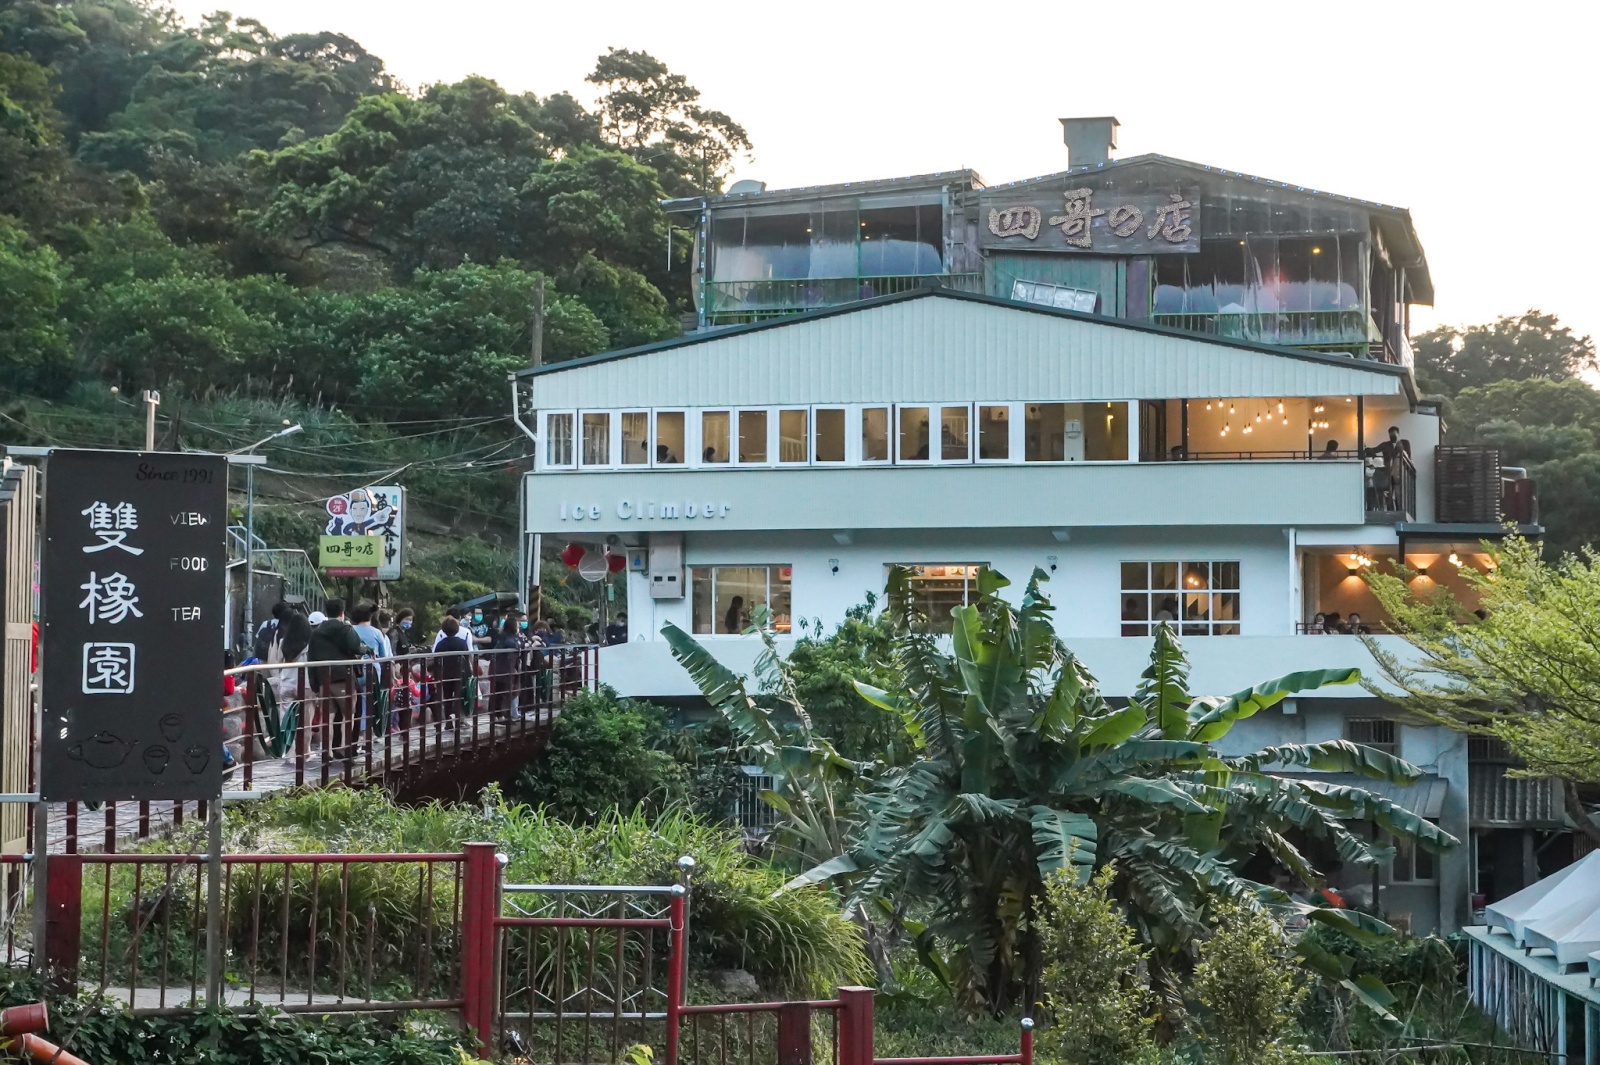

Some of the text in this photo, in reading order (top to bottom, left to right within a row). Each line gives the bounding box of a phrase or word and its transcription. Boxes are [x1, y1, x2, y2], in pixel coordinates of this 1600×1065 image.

[988, 187, 1193, 249] 四哥の店
[136, 462, 214, 484] Since 1991
[170, 512, 211, 526] VIEW
[560, 500, 731, 521] Ice Climber
[326, 541, 374, 557] 四哥の店
[170, 557, 209, 572] FOOD
[79, 500, 145, 695] 雙橡園
[171, 606, 201, 621] TEA
